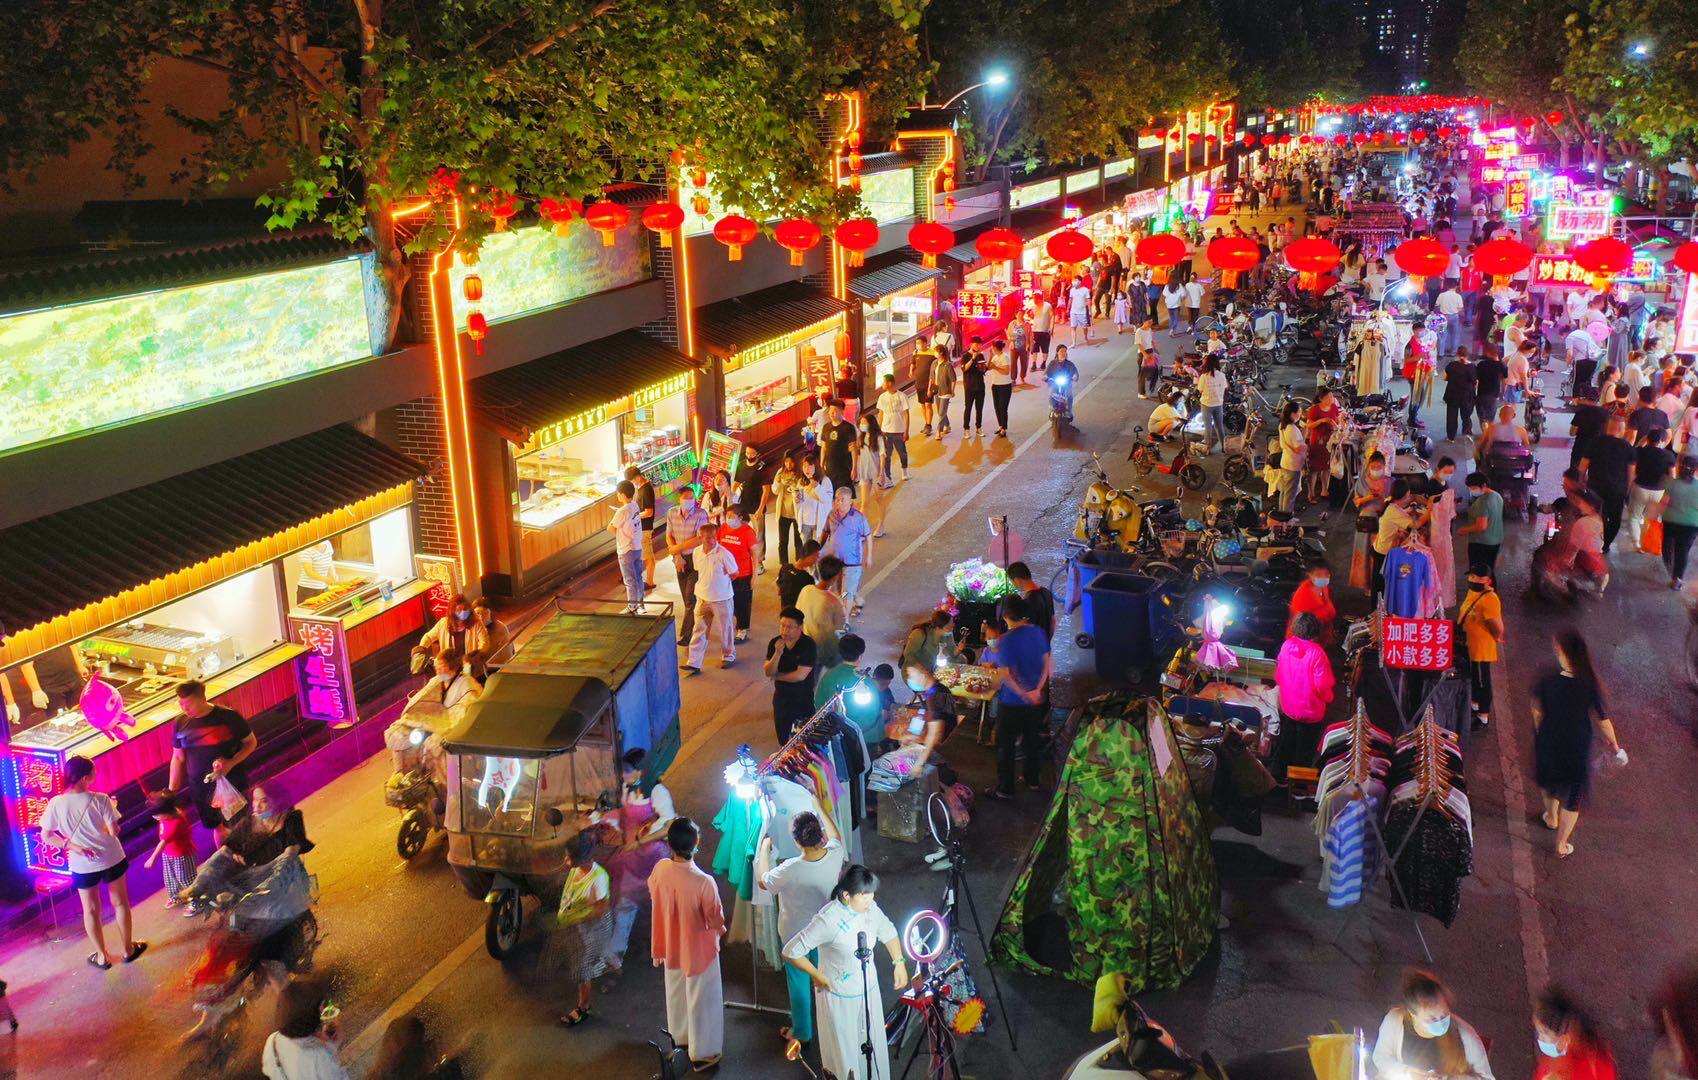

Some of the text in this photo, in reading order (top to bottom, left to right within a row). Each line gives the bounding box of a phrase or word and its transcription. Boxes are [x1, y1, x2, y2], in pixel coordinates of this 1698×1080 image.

[1387, 621, 1450, 644] 加肥多多
[1387, 645, 1450, 667] 小款多多
